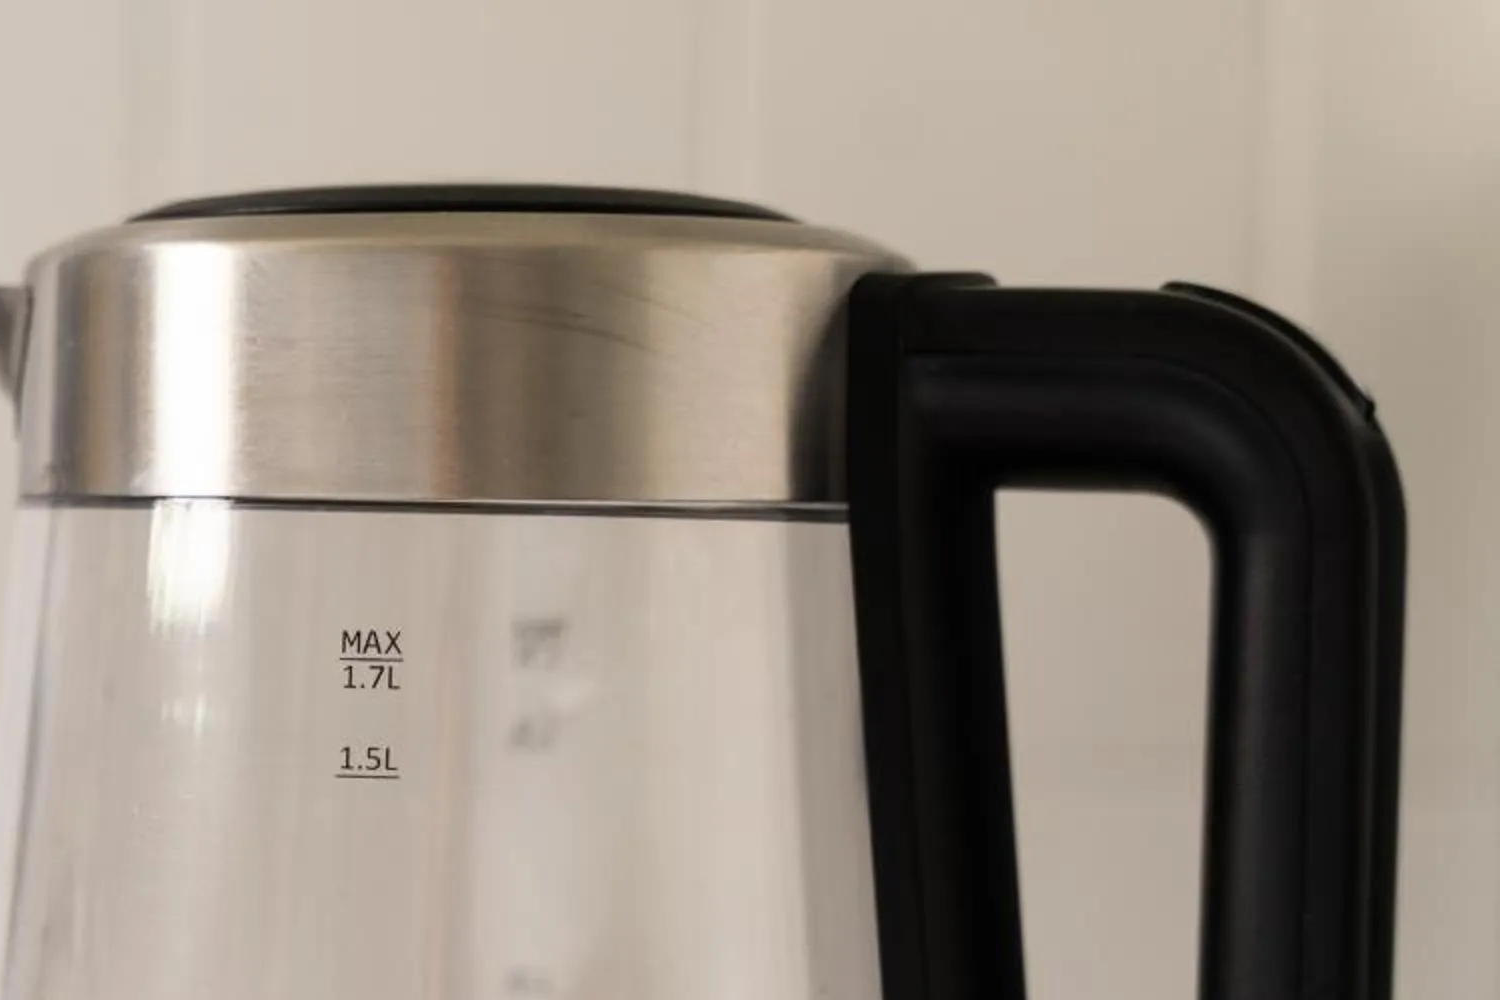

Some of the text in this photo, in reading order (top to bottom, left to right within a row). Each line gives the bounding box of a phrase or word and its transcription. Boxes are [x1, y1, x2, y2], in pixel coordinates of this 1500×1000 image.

[341, 629, 402, 654] MAX
[343, 665, 401, 689] 1.7L
[340, 746, 398, 771] 1.5L
